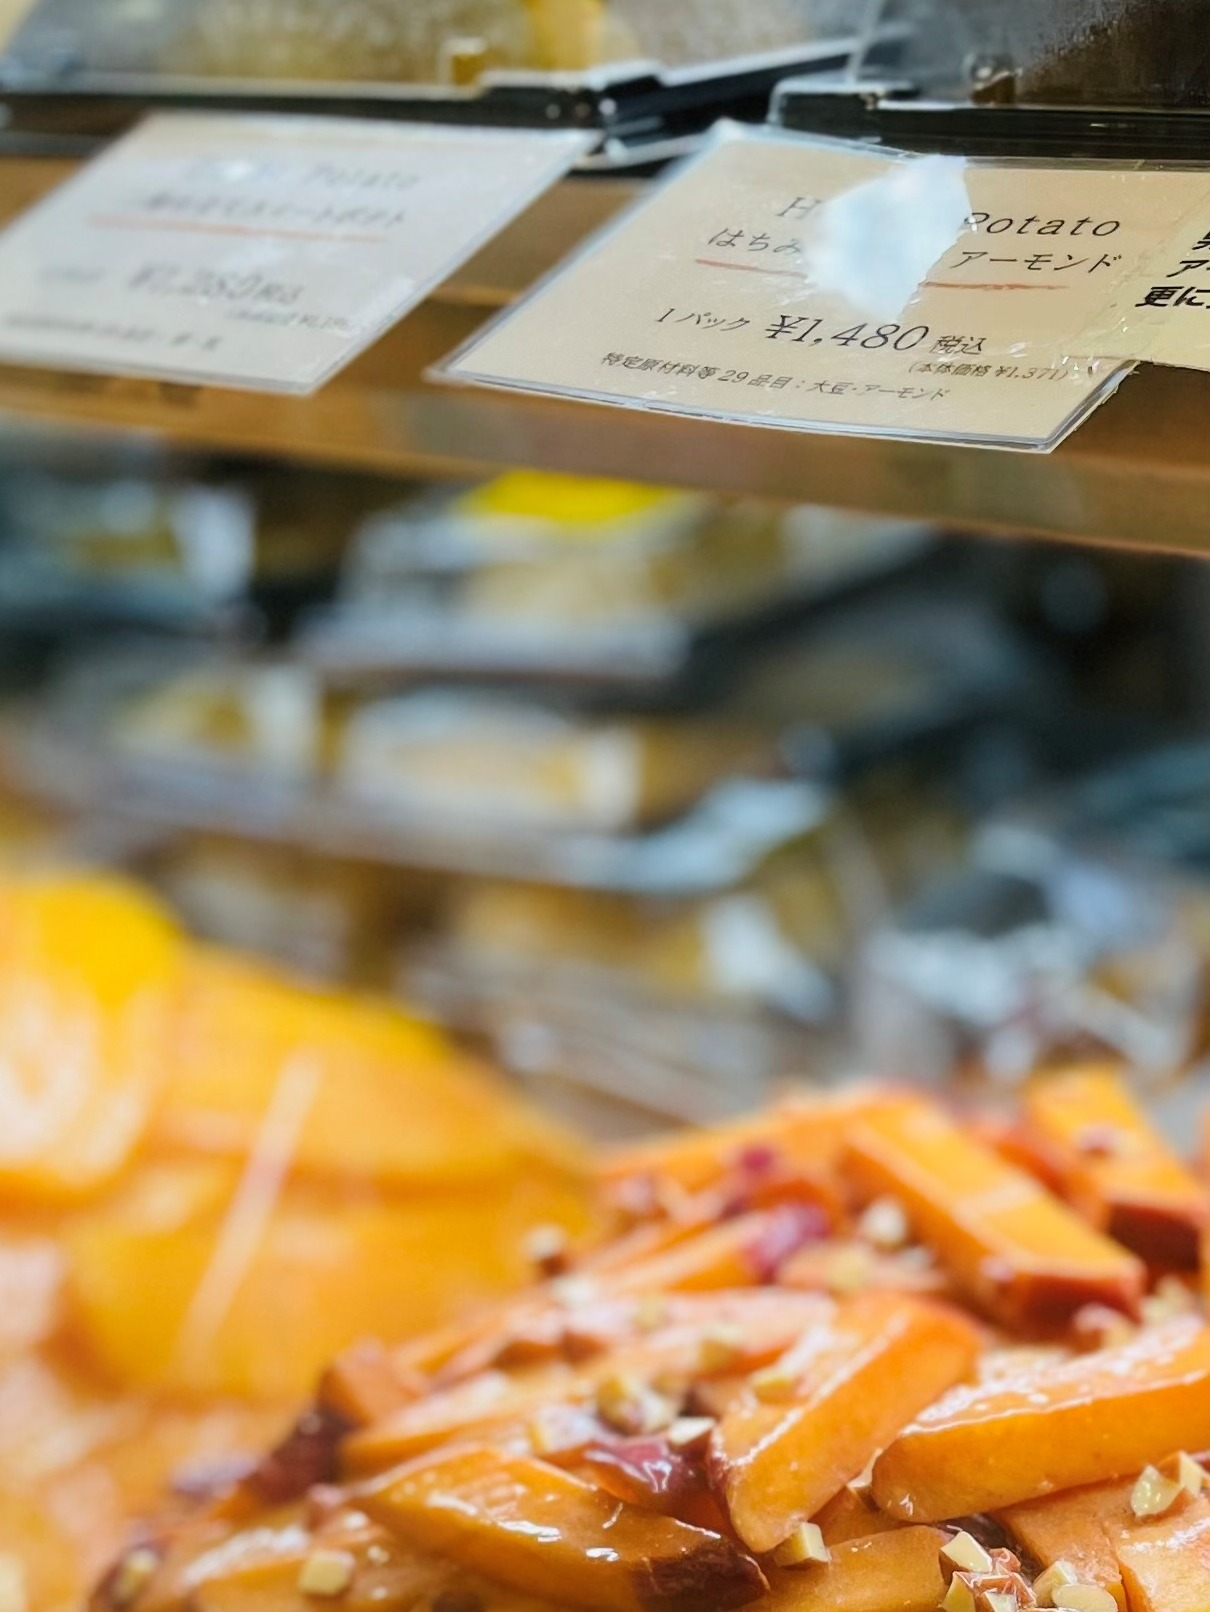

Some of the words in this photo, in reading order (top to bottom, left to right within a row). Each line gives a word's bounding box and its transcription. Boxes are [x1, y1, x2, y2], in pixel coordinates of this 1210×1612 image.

[951, 251, 1122, 274] アーモンド
[765, 313, 930, 351] ¥1,480
